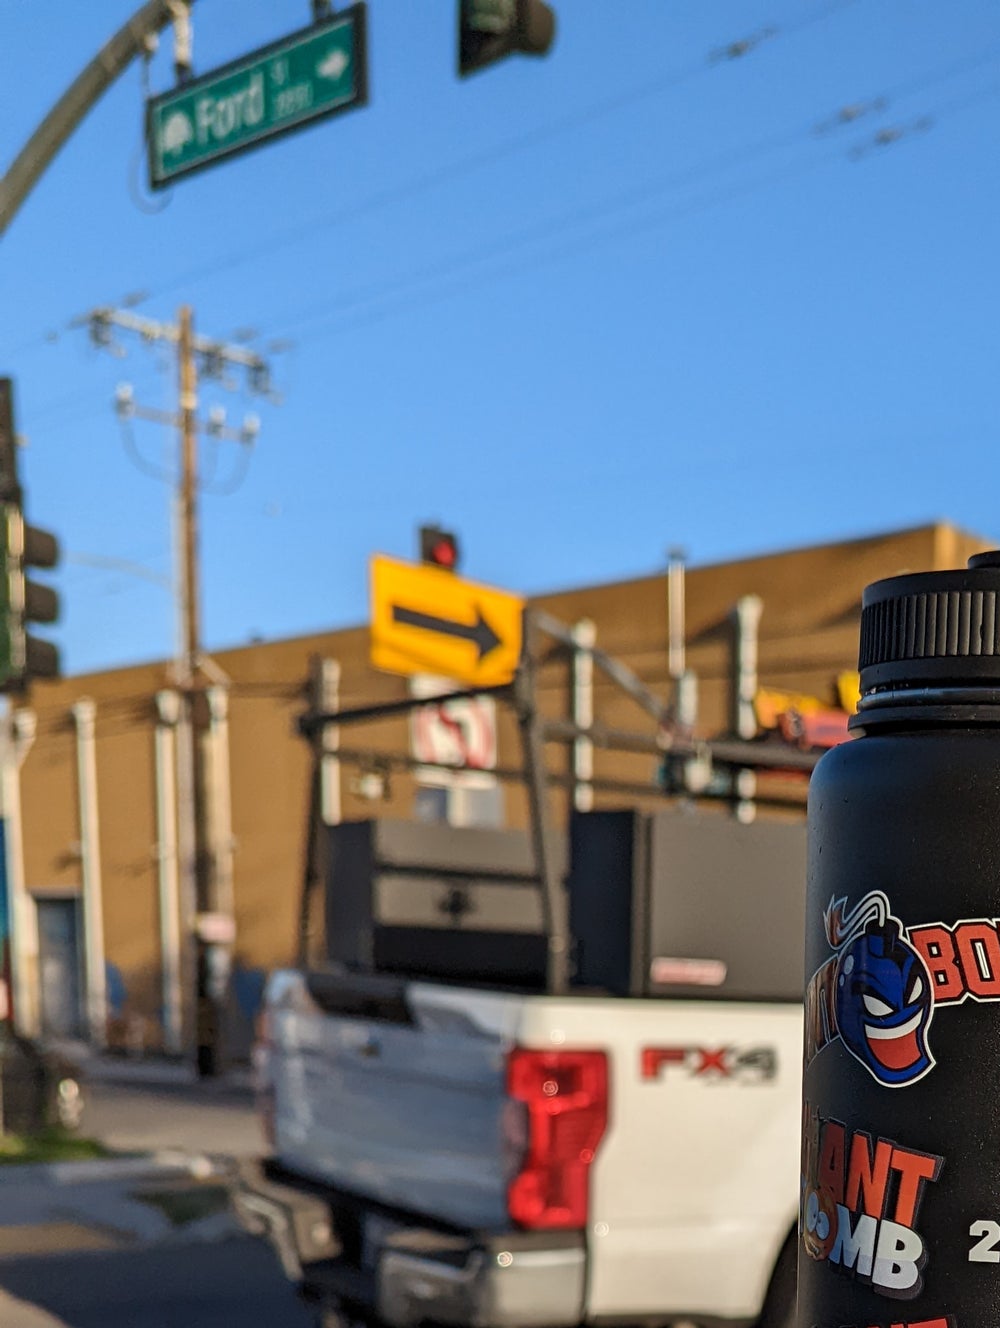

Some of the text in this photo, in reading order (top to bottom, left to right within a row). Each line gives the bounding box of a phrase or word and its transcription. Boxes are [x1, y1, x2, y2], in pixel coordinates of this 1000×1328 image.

[195, 71, 264, 145] Ford
[640, 1046, 777, 1081] FX4
[803, 1104, 936, 1229] ANT
